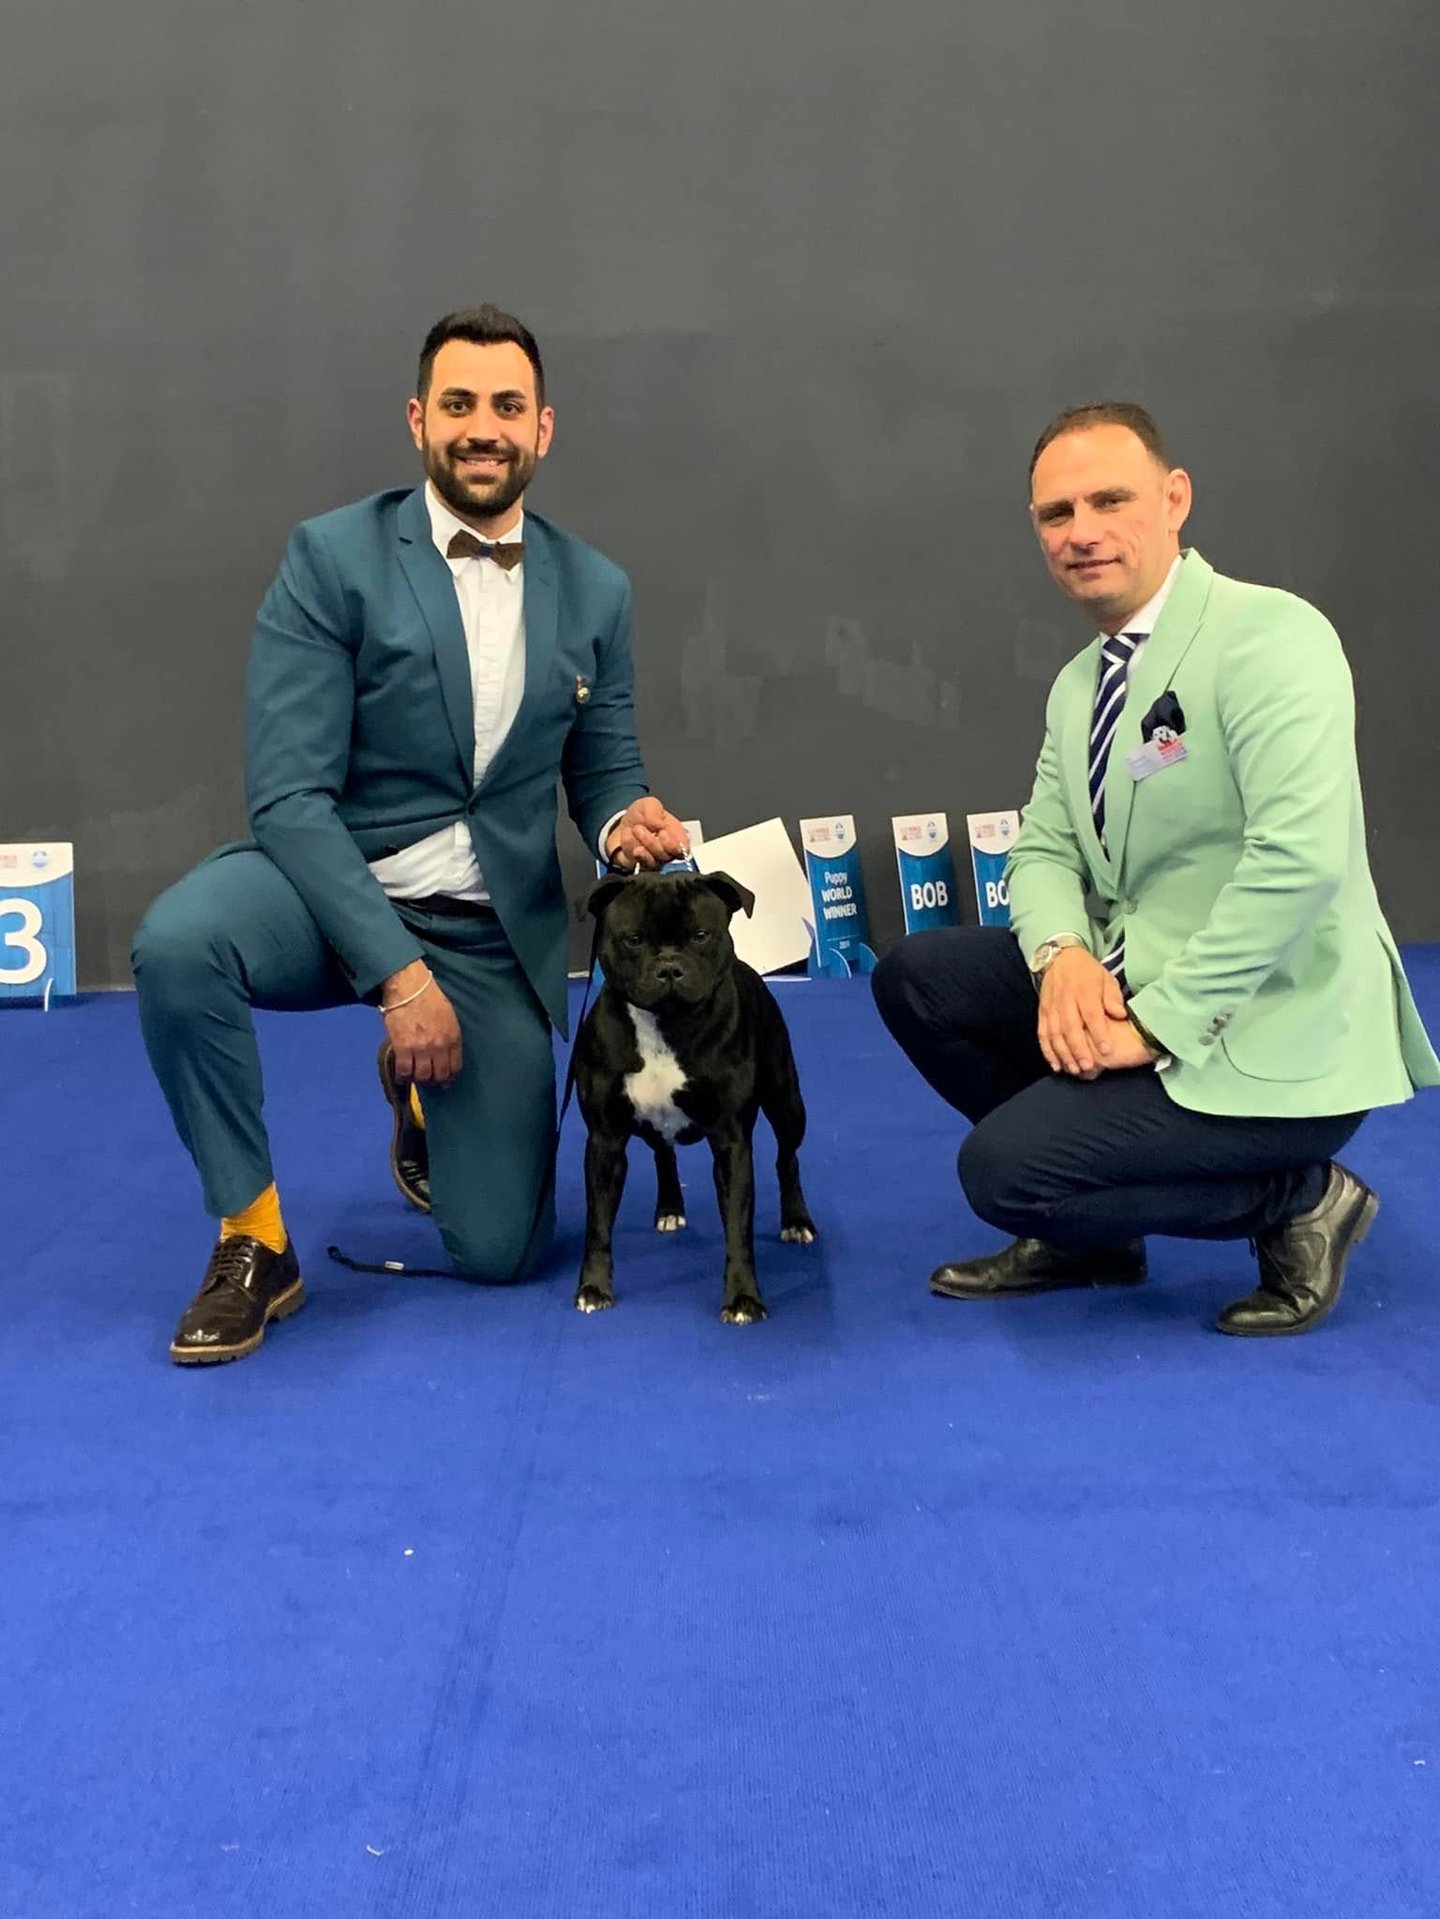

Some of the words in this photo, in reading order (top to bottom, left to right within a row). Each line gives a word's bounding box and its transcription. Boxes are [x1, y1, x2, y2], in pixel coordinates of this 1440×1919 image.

[824, 871, 848, 885] Puppy
[821, 885, 853, 902] WORLD
[910, 880, 949, 911] BOB
[985, 879, 1010, 908] BO
[823, 902, 858, 920] WINNER
[0, 897, 48, 985] 3
